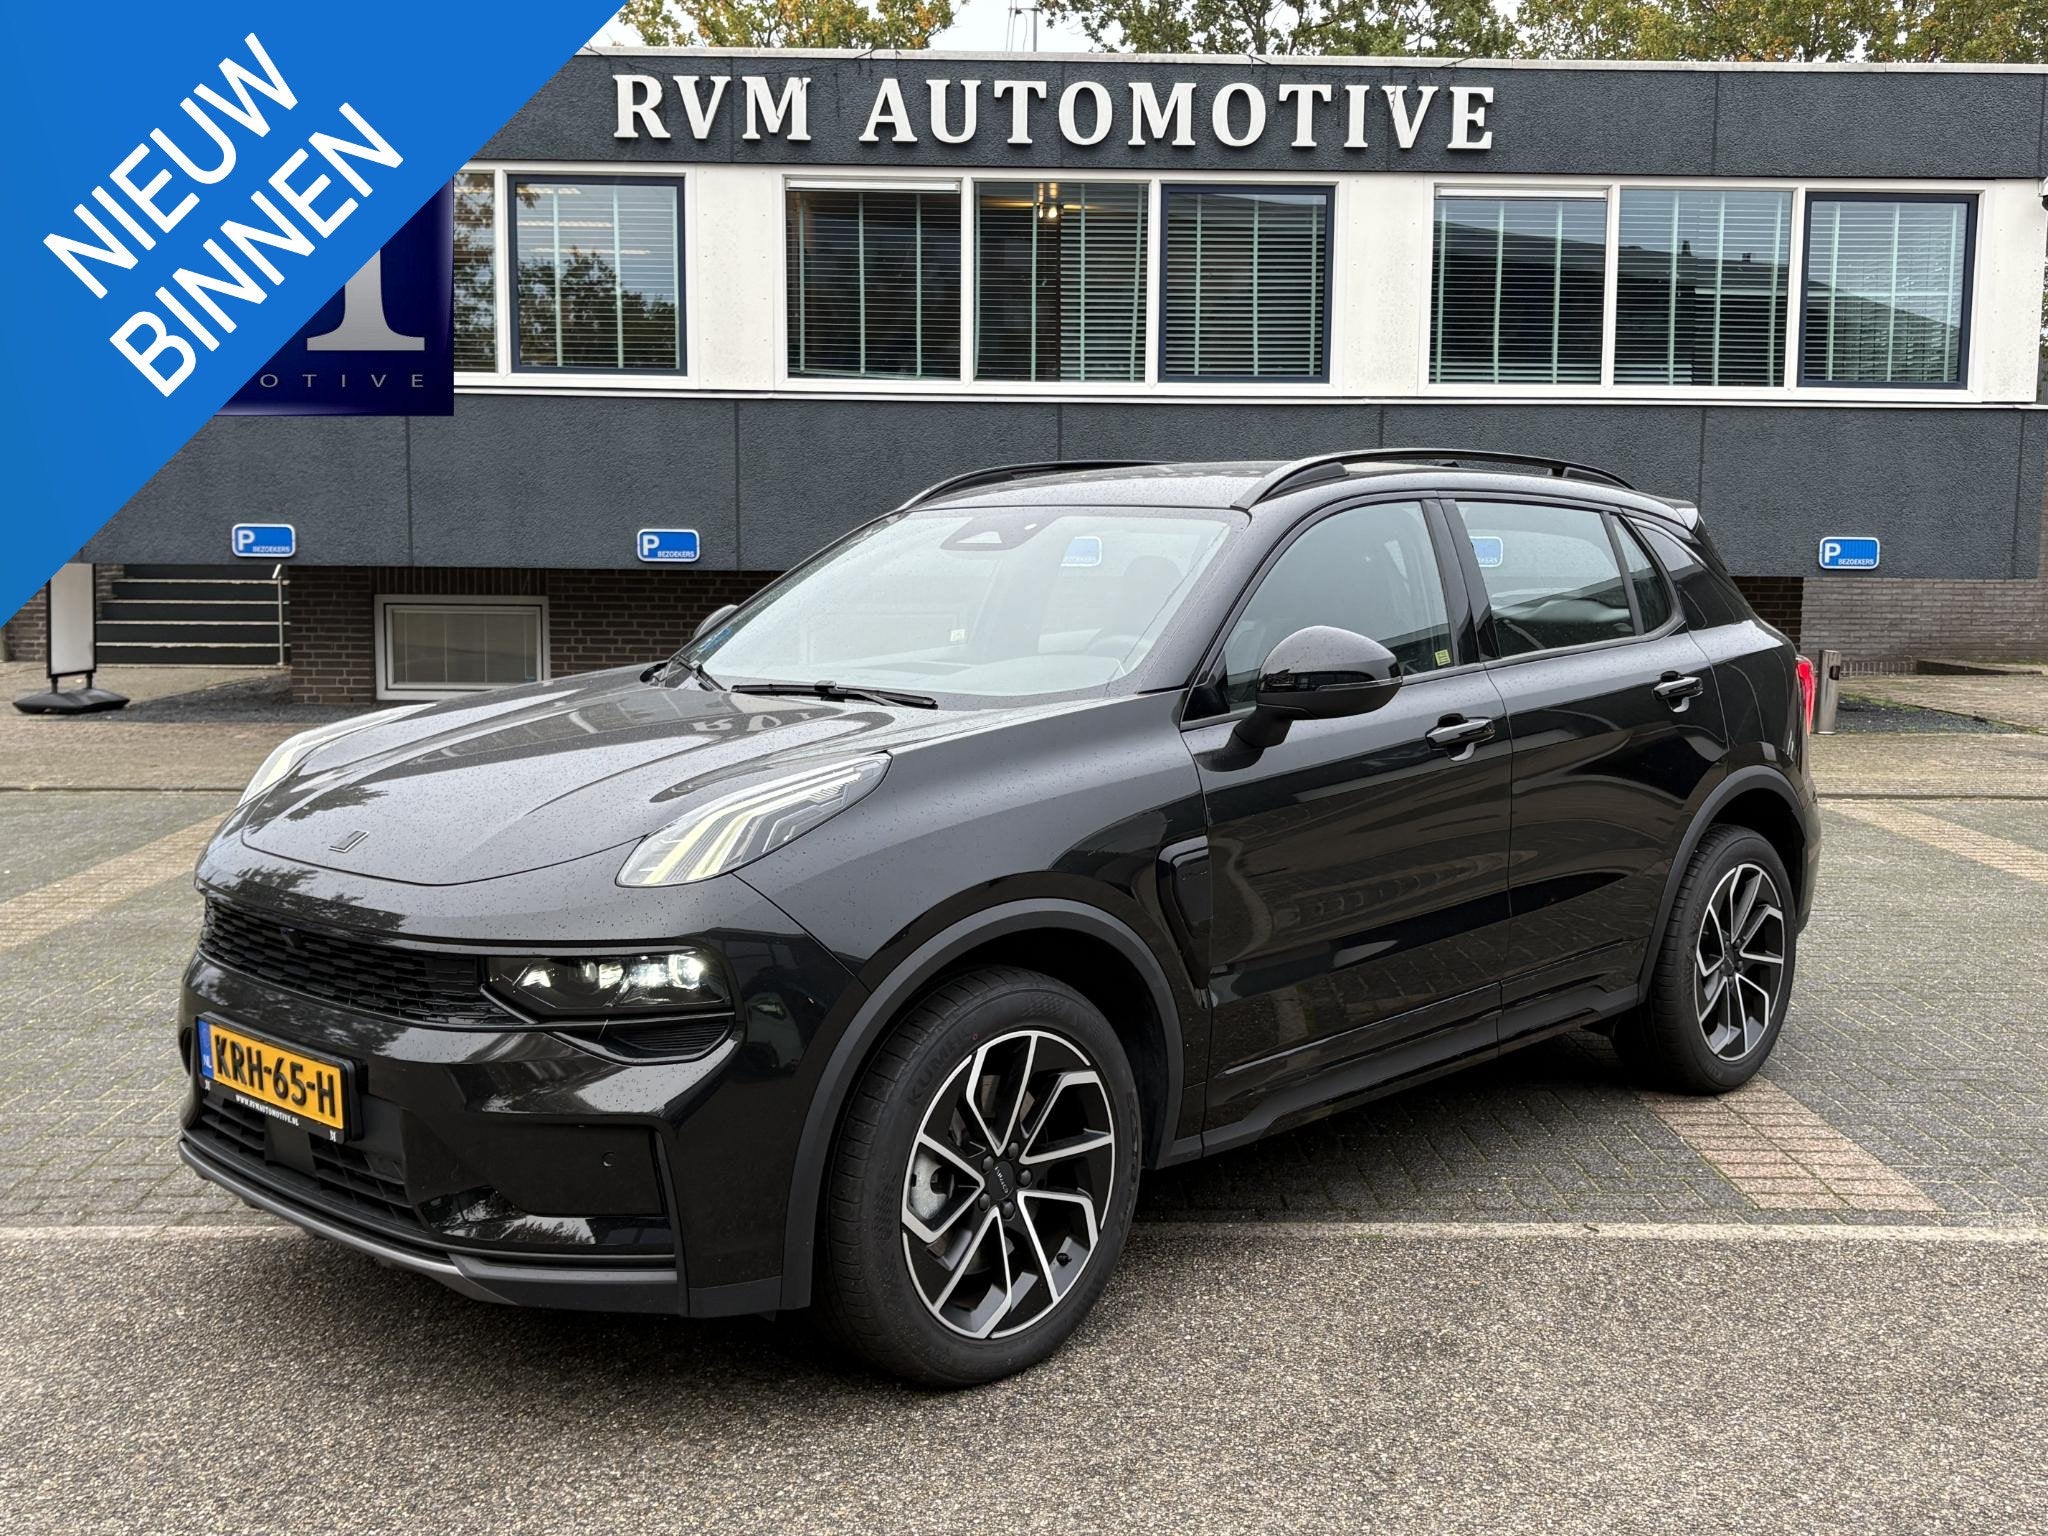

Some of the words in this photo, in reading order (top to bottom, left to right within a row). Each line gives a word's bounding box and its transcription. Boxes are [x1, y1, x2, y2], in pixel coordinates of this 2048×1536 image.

[612, 74, 811, 140] RVM
[858, 78, 1495, 149] AUTOMOTIVE
[259, 373, 424, 388] OTIVE
[238, 530, 256, 551] P
[643, 534, 660, 556] P
[657, 550, 695, 558] BEZOEKERS
[1824, 542, 1841, 564] P
[1838, 558, 1875, 566] BEZOEKERS
[214, 1034, 336, 1119] KRH-65-H
